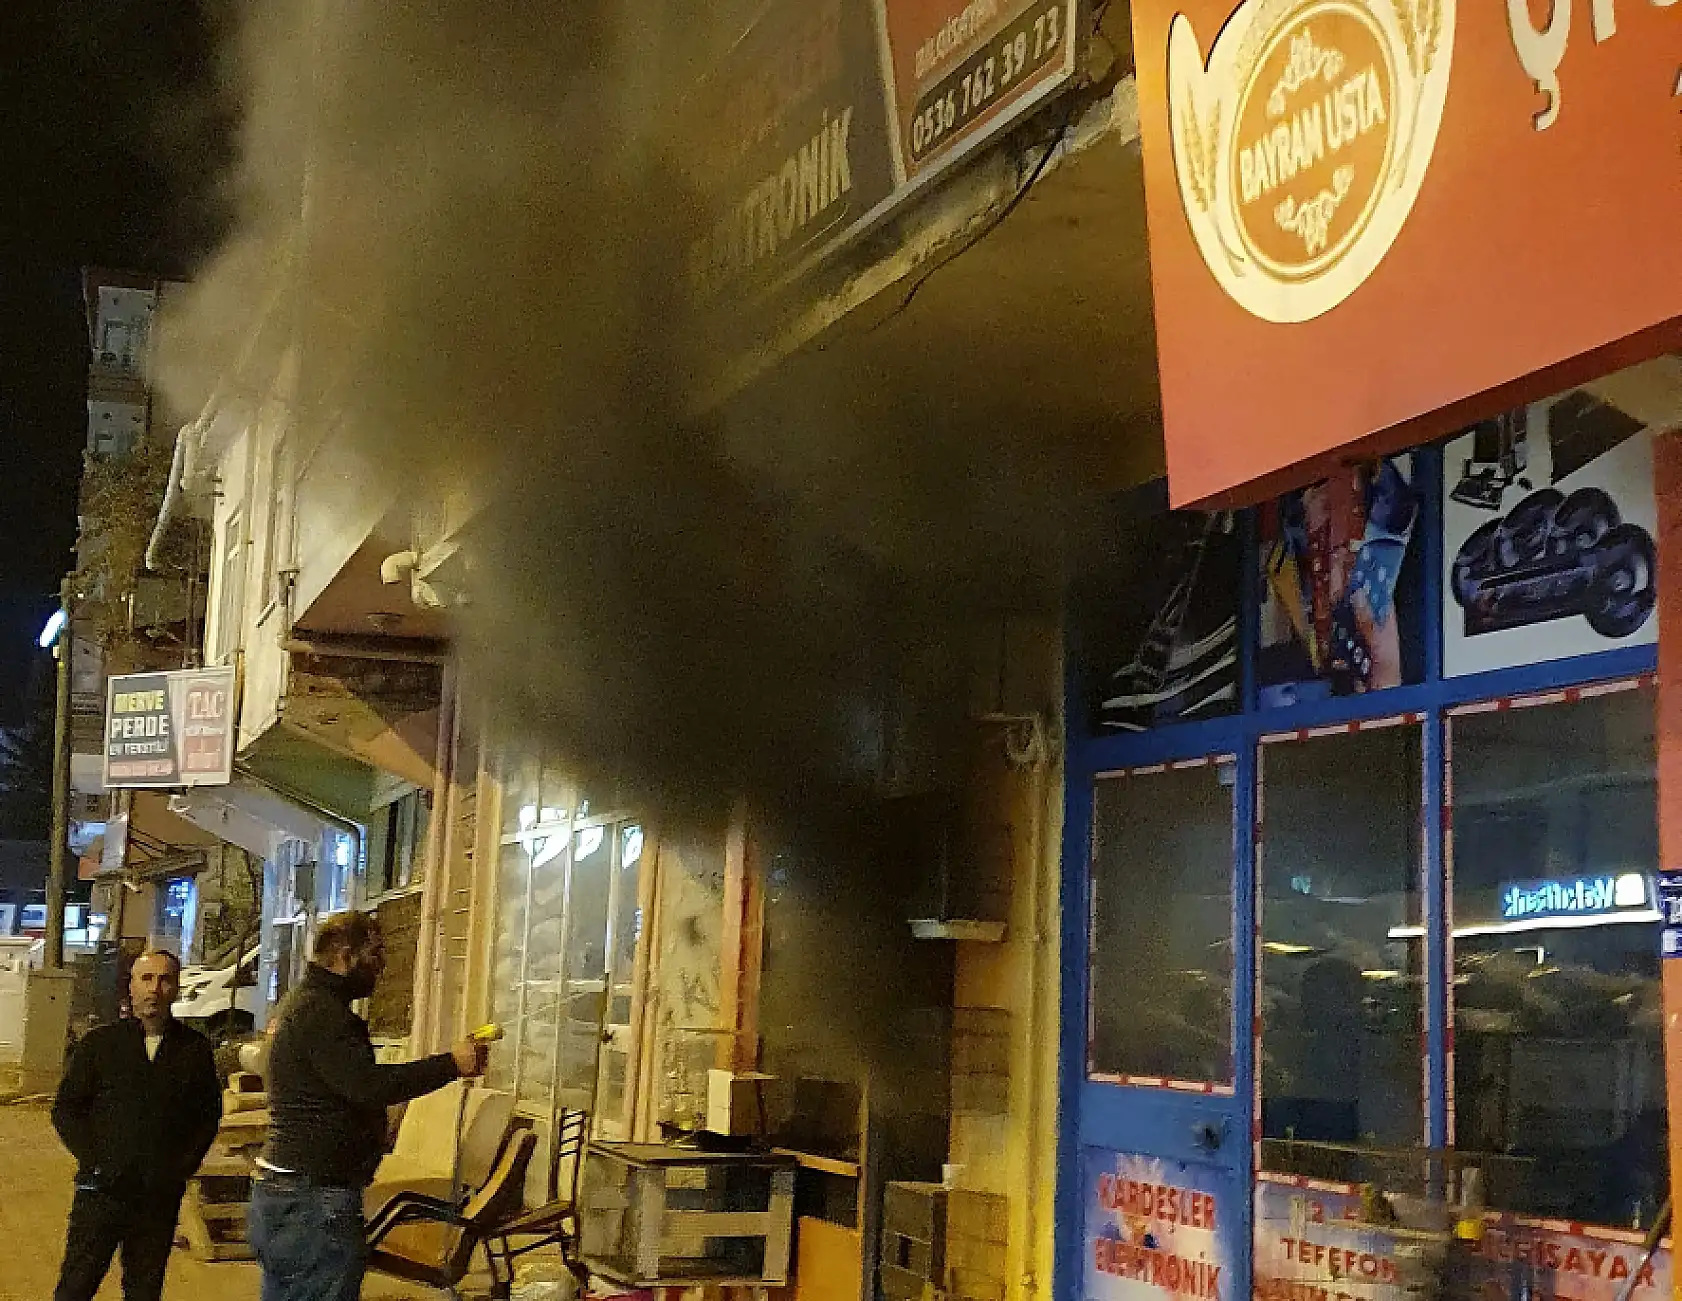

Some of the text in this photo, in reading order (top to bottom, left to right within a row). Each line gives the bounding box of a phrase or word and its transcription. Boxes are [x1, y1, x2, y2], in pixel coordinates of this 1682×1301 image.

[962, 56, 995, 116] 762
[1001, 31, 1027, 87] 39
[1033, 5, 1059, 60] 73
[1240, 62, 1387, 204] BAYRAM USTA
[111, 715, 170, 738] PERDE
